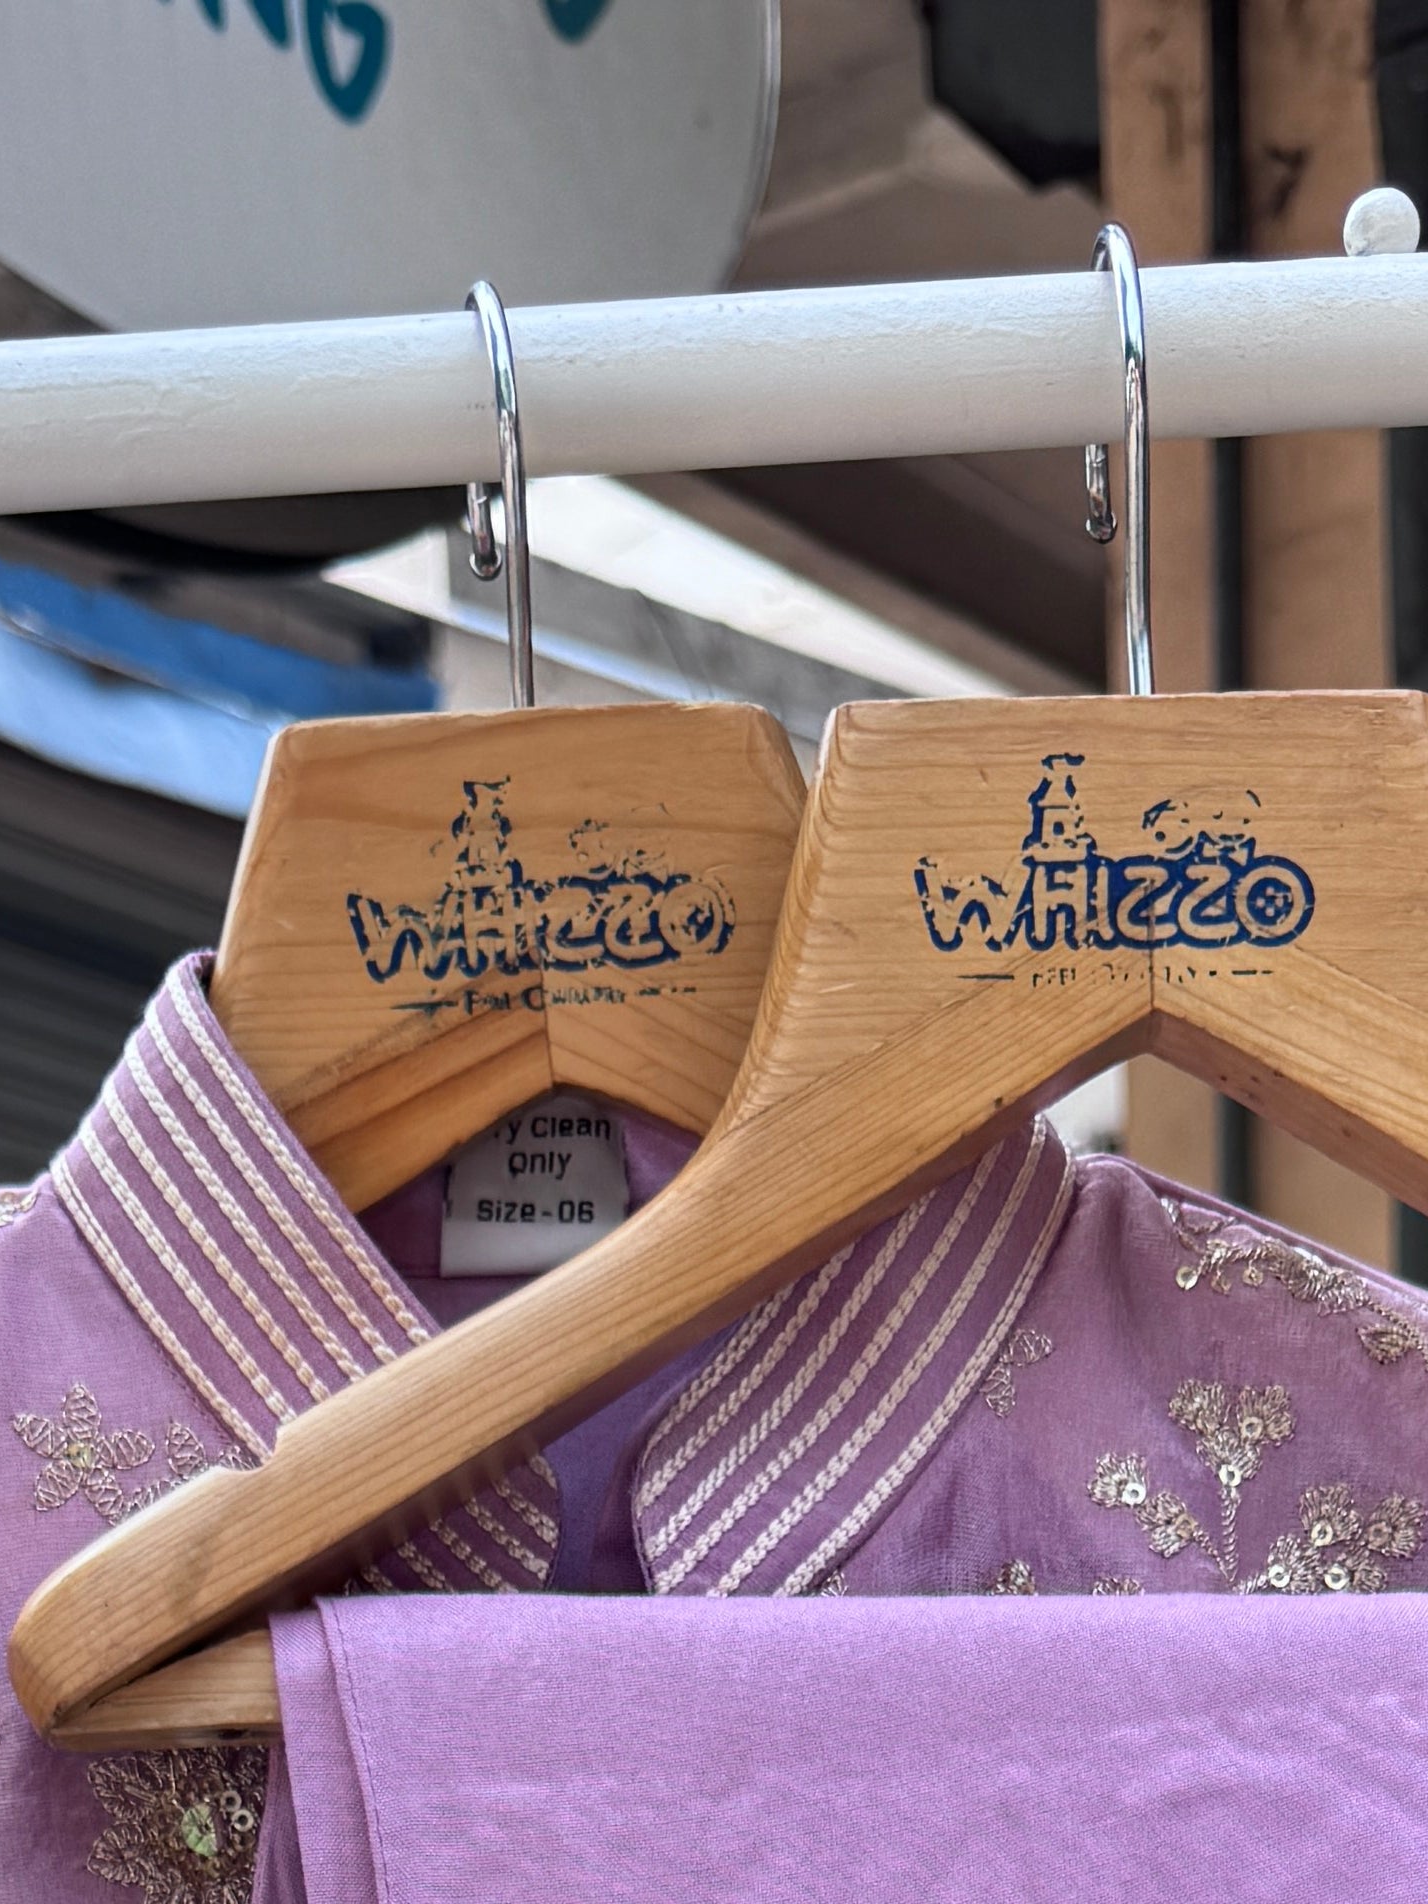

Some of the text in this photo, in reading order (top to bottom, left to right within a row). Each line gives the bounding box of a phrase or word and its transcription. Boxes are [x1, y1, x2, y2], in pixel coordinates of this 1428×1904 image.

[914, 854, 1316, 952] WHIZZO
[530, 1116, 611, 1141] Clean
[508, 1151, 572, 1180] Only
